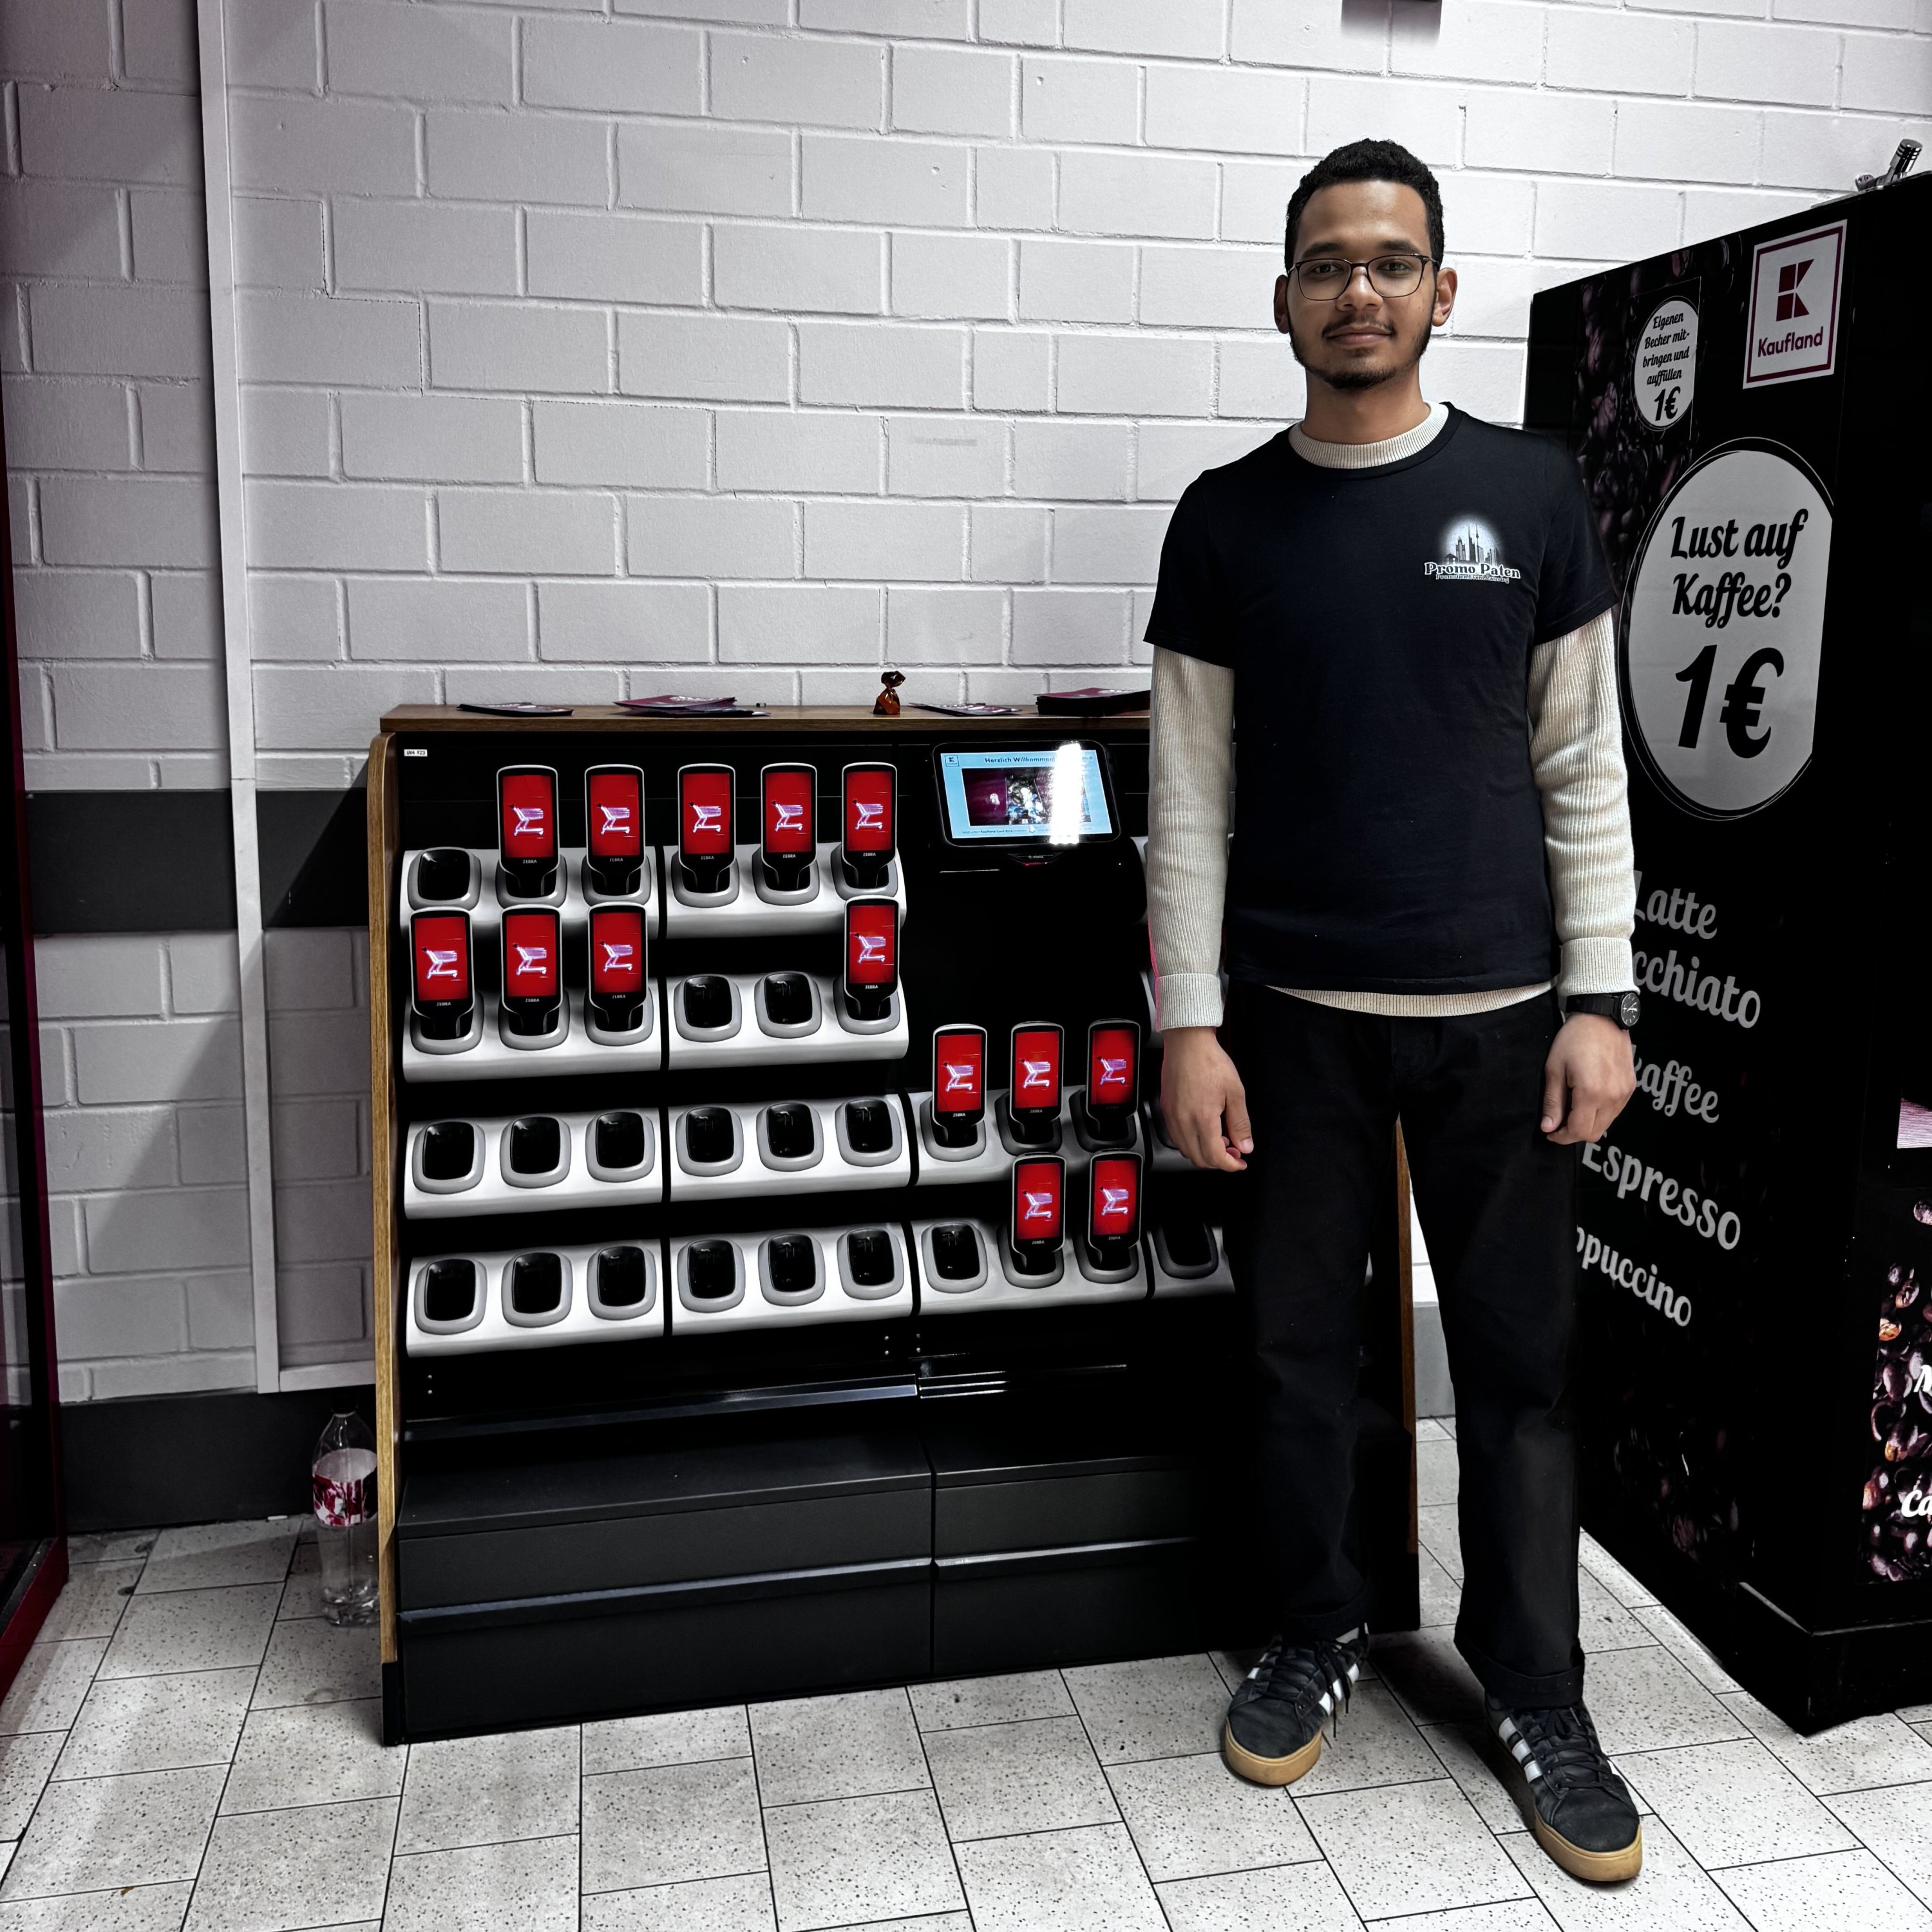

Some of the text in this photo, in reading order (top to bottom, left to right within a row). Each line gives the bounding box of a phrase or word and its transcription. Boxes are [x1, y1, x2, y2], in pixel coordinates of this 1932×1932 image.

[1653, 312, 1684, 330] Eigenen
[1644, 328, 1690, 350] Becher mit-
[1757, 326, 1824, 358] Kaufland
[1642, 346, 1690, 368] bringen und
[1647, 368, 1682, 387] auffüllen
[1654, 386, 1681, 422] 1€
[1671, 508, 1809, 570] Lust auf
[1424, 562, 1476, 575] Promo
[1479, 562, 1521, 580] Paten
[1672, 571, 1792, 629] Kaffee?
[1633, 949, 1761, 1028] cchiato
[1631, 1043, 1719, 1123] affee
[1582, 1130, 1741, 1250] Espresso
